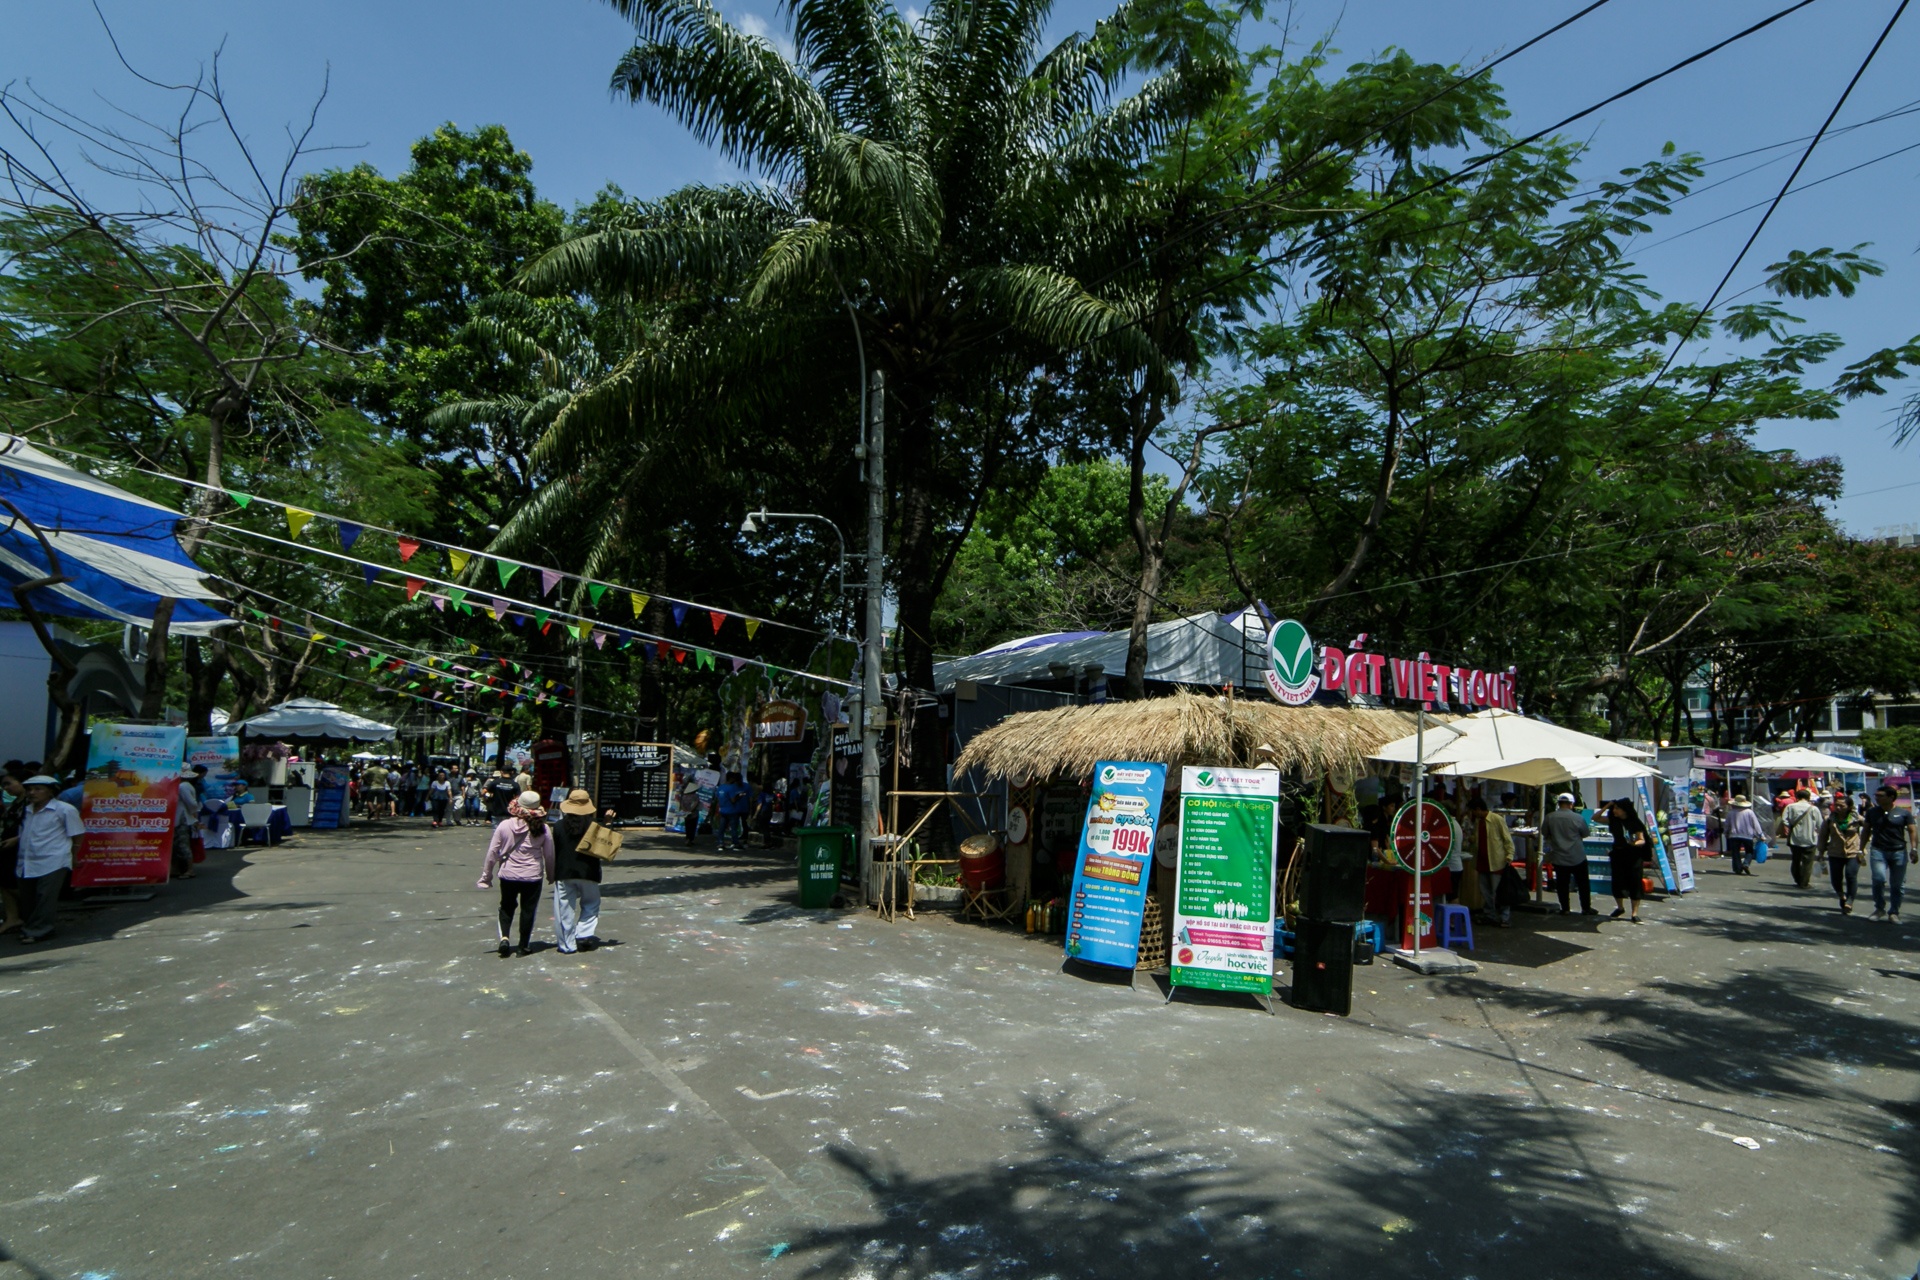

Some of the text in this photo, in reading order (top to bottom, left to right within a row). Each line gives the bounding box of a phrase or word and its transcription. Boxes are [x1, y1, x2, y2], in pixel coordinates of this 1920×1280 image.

[1319, 633, 1518, 711] ĐẤT VIỆT TOUR
[1300, 680, 1316, 700] TOUR
[1202, 799, 1217, 808] HỘI
[1219, 800, 1240, 808] NGHỀ
[1242, 802, 1270, 811] NGHIỆP
[1116, 812, 1154, 826] CỰC SỐC
[1112, 828, 1150, 854] 199k
[1197, 951, 1223, 964] Tuyển
[1227, 958, 1267, 973] học việc
